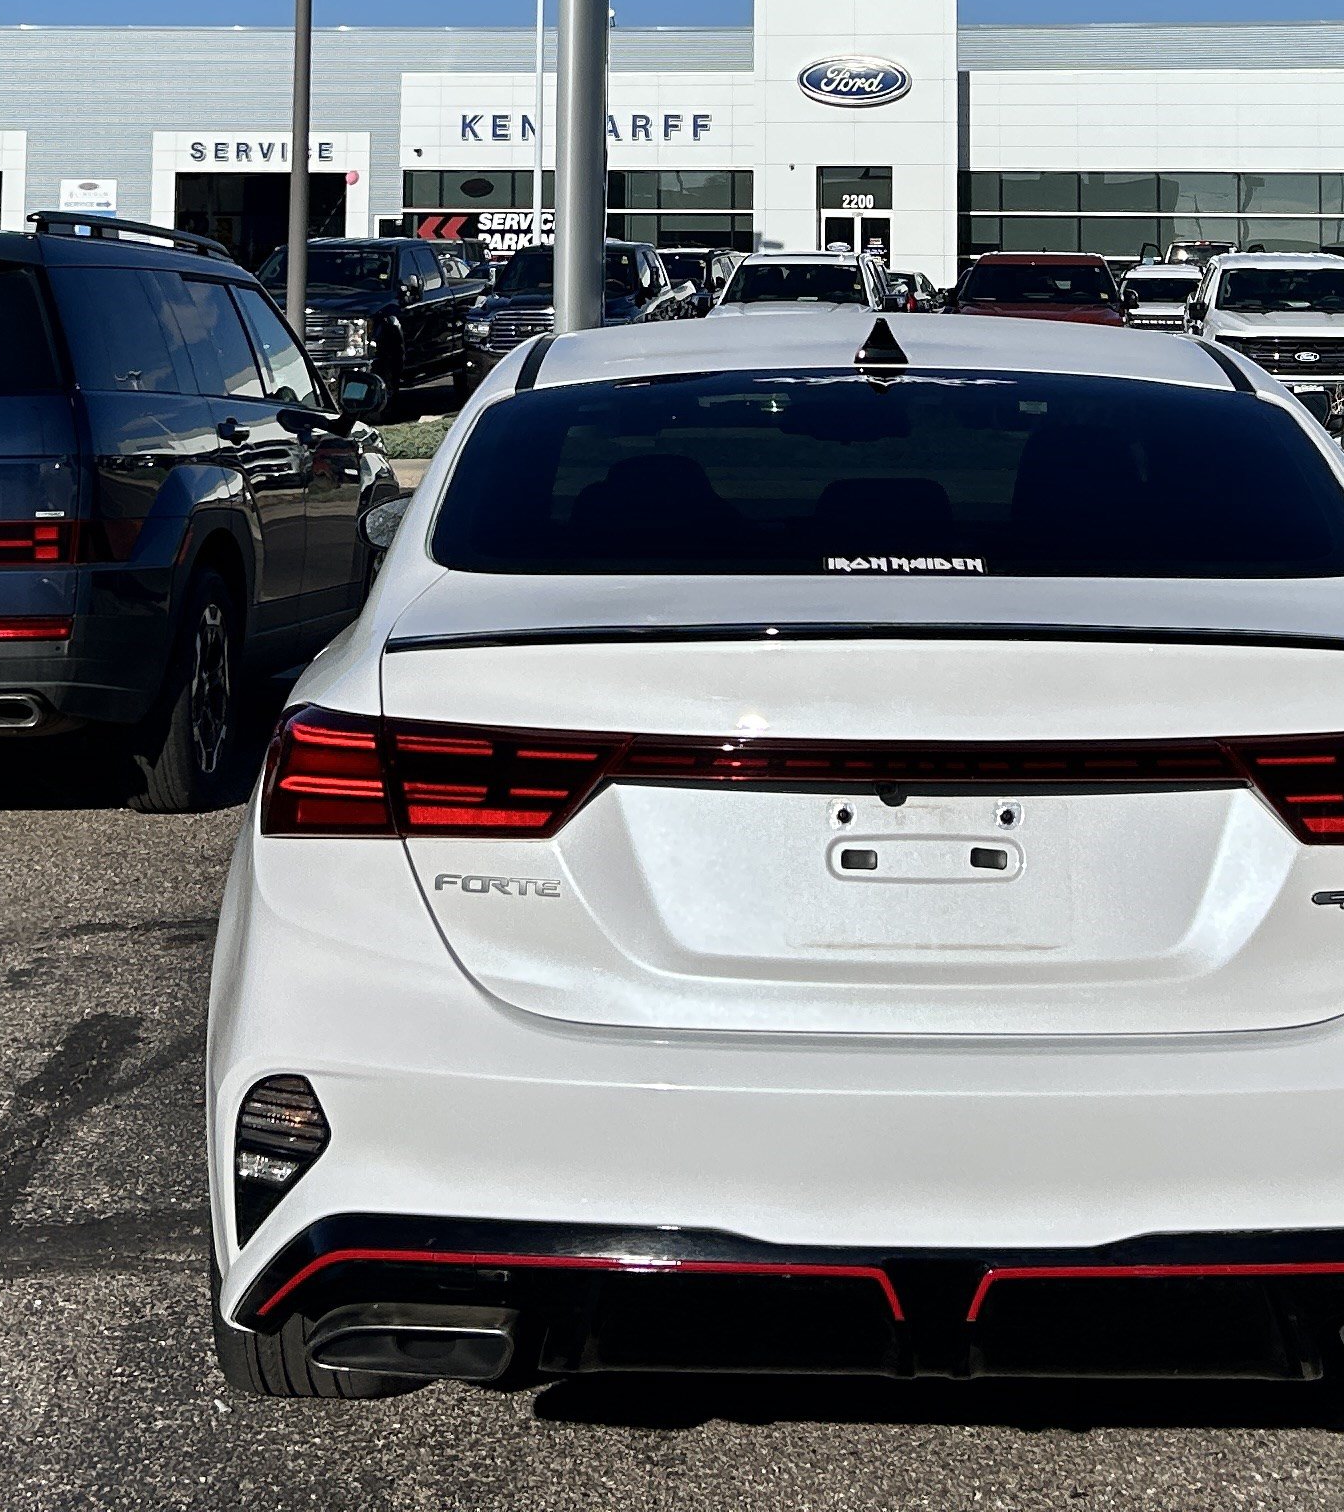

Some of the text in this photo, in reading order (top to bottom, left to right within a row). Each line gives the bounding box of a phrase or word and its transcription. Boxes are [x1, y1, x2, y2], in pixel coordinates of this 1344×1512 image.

[820, 65, 885, 92] Ford
[461, 114, 713, 141] KEN ARFF
[190, 142, 334, 162] SERVIE
[842, 194, 875, 209] 2200
[477, 213, 555, 230] SERVC
[828, 557, 984, 574] IRON MAIDEN
[434, 873, 561, 898] FORTE
